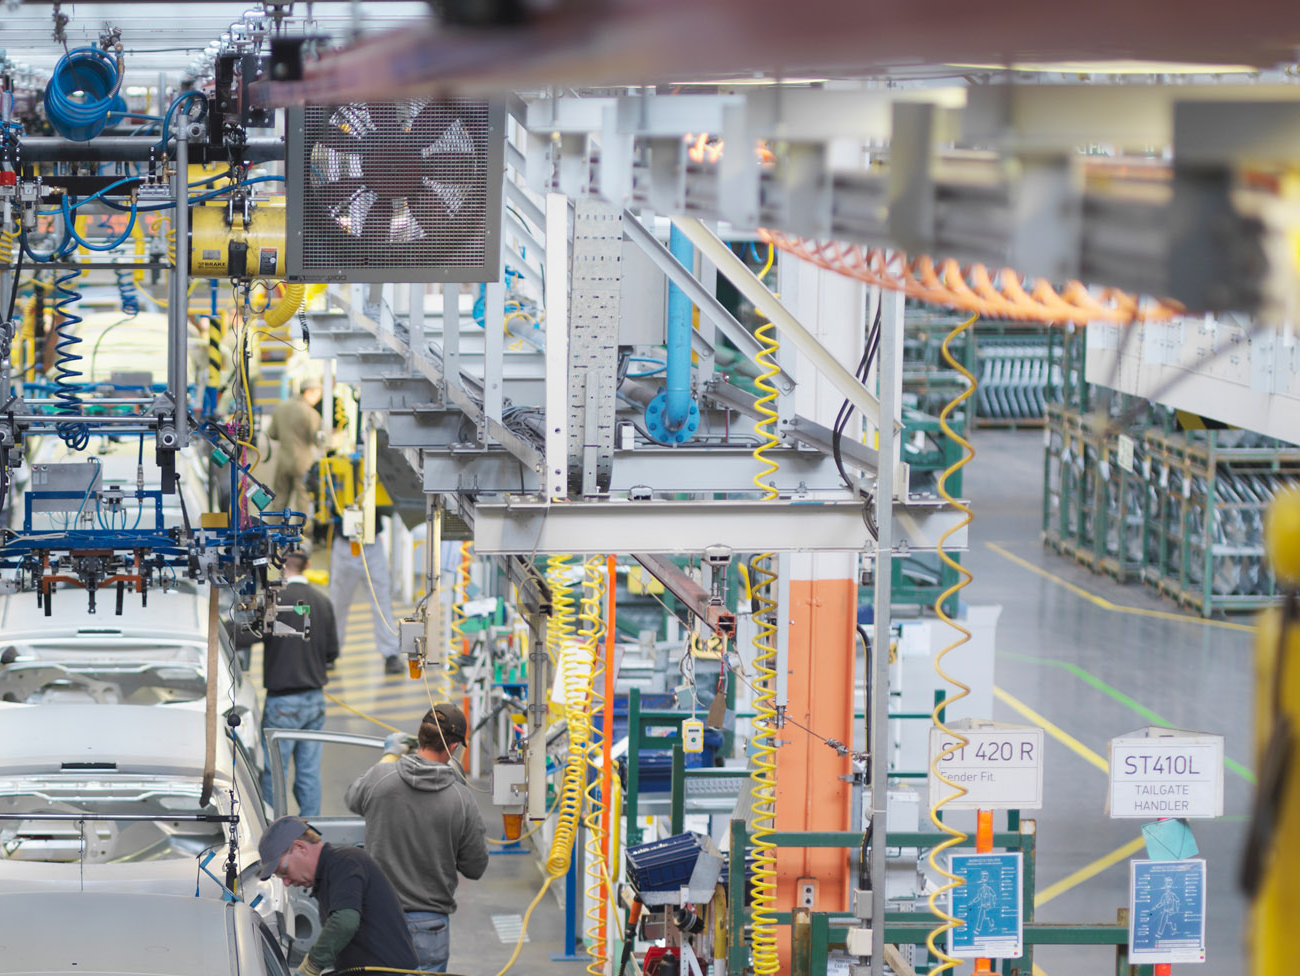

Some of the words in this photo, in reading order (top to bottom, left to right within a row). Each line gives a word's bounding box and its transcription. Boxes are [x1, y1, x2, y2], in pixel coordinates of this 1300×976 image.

[941, 741, 966, 761] ST
[975, 741, 1014, 761] 420
[1020, 741, 1034, 761] R
[1124, 755, 1201, 775] ST410L
[1134, 784, 1189, 796] TAILGATE
[1134, 800, 1190, 811] HANDLER
